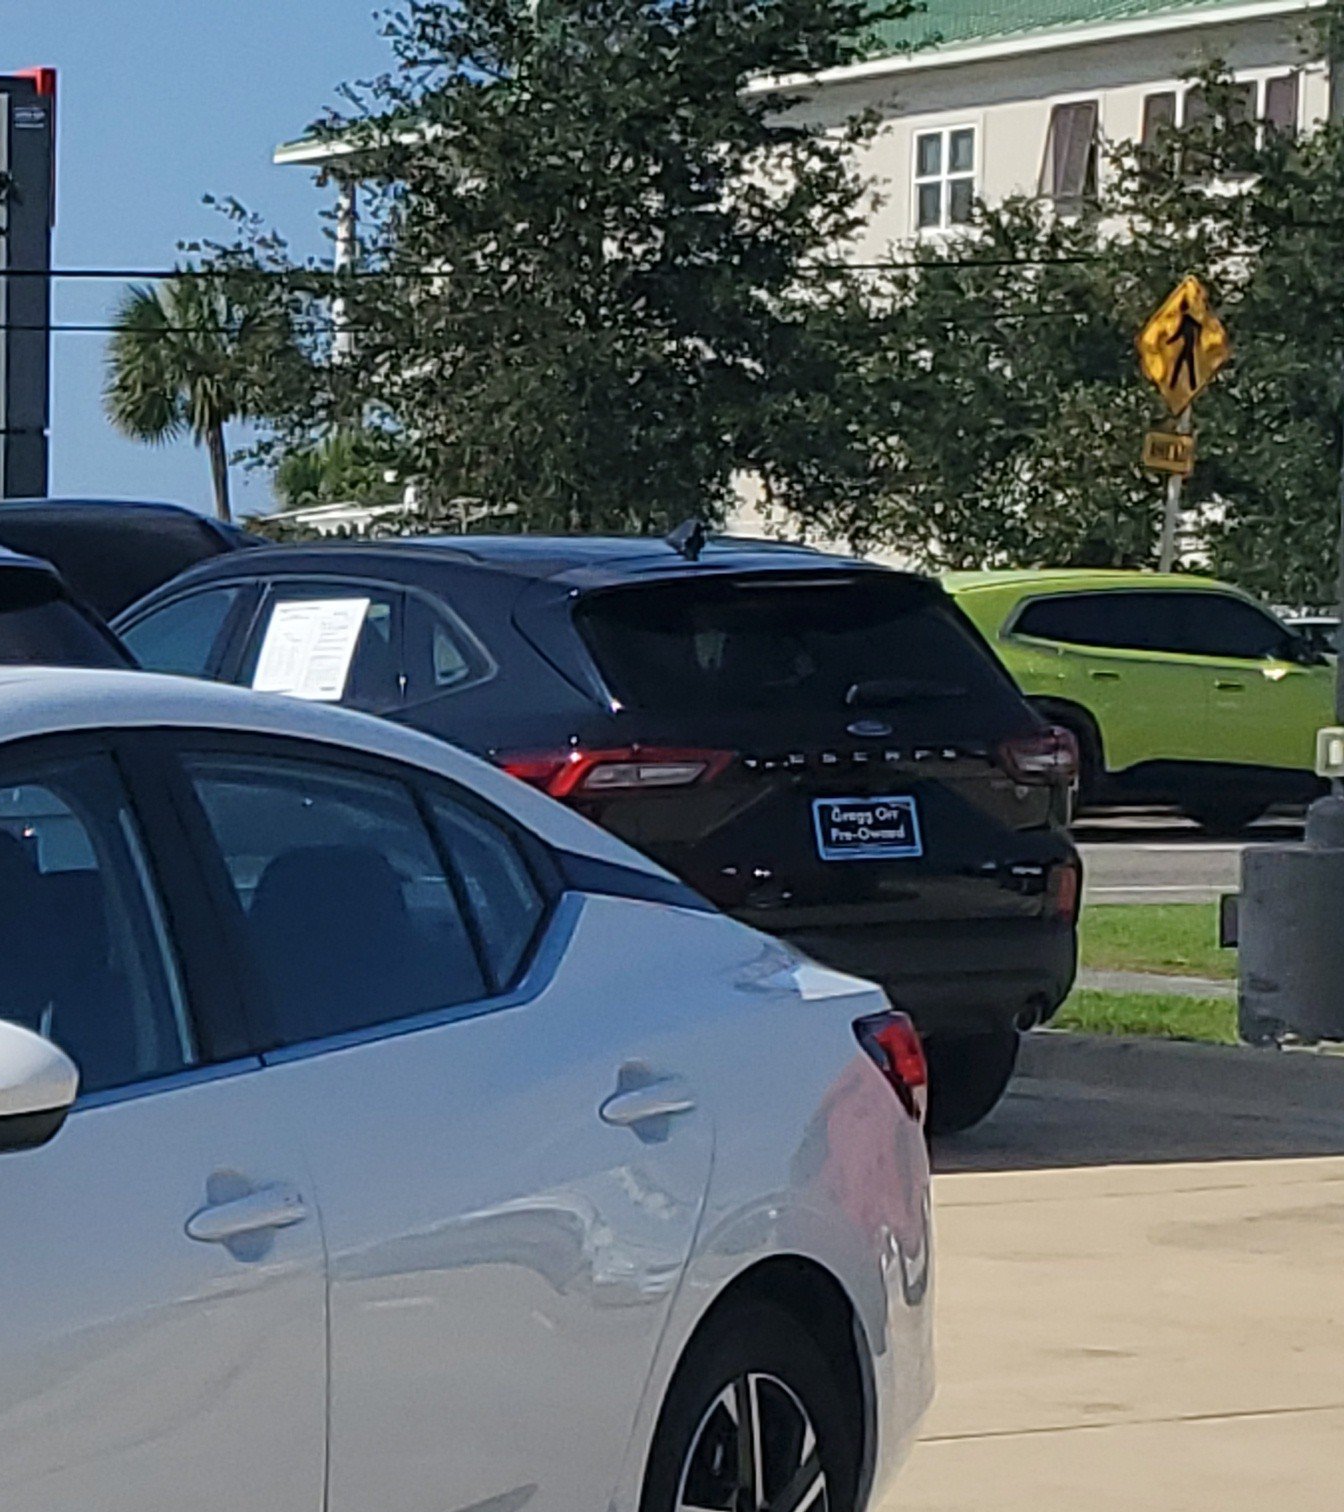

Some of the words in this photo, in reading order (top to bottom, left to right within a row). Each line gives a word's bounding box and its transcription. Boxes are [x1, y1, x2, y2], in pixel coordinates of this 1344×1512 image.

[831, 807, 873, 825] Gregg
[875, 806, 900, 820] Orr
[830, 823, 906, 842] Pre-Owned
